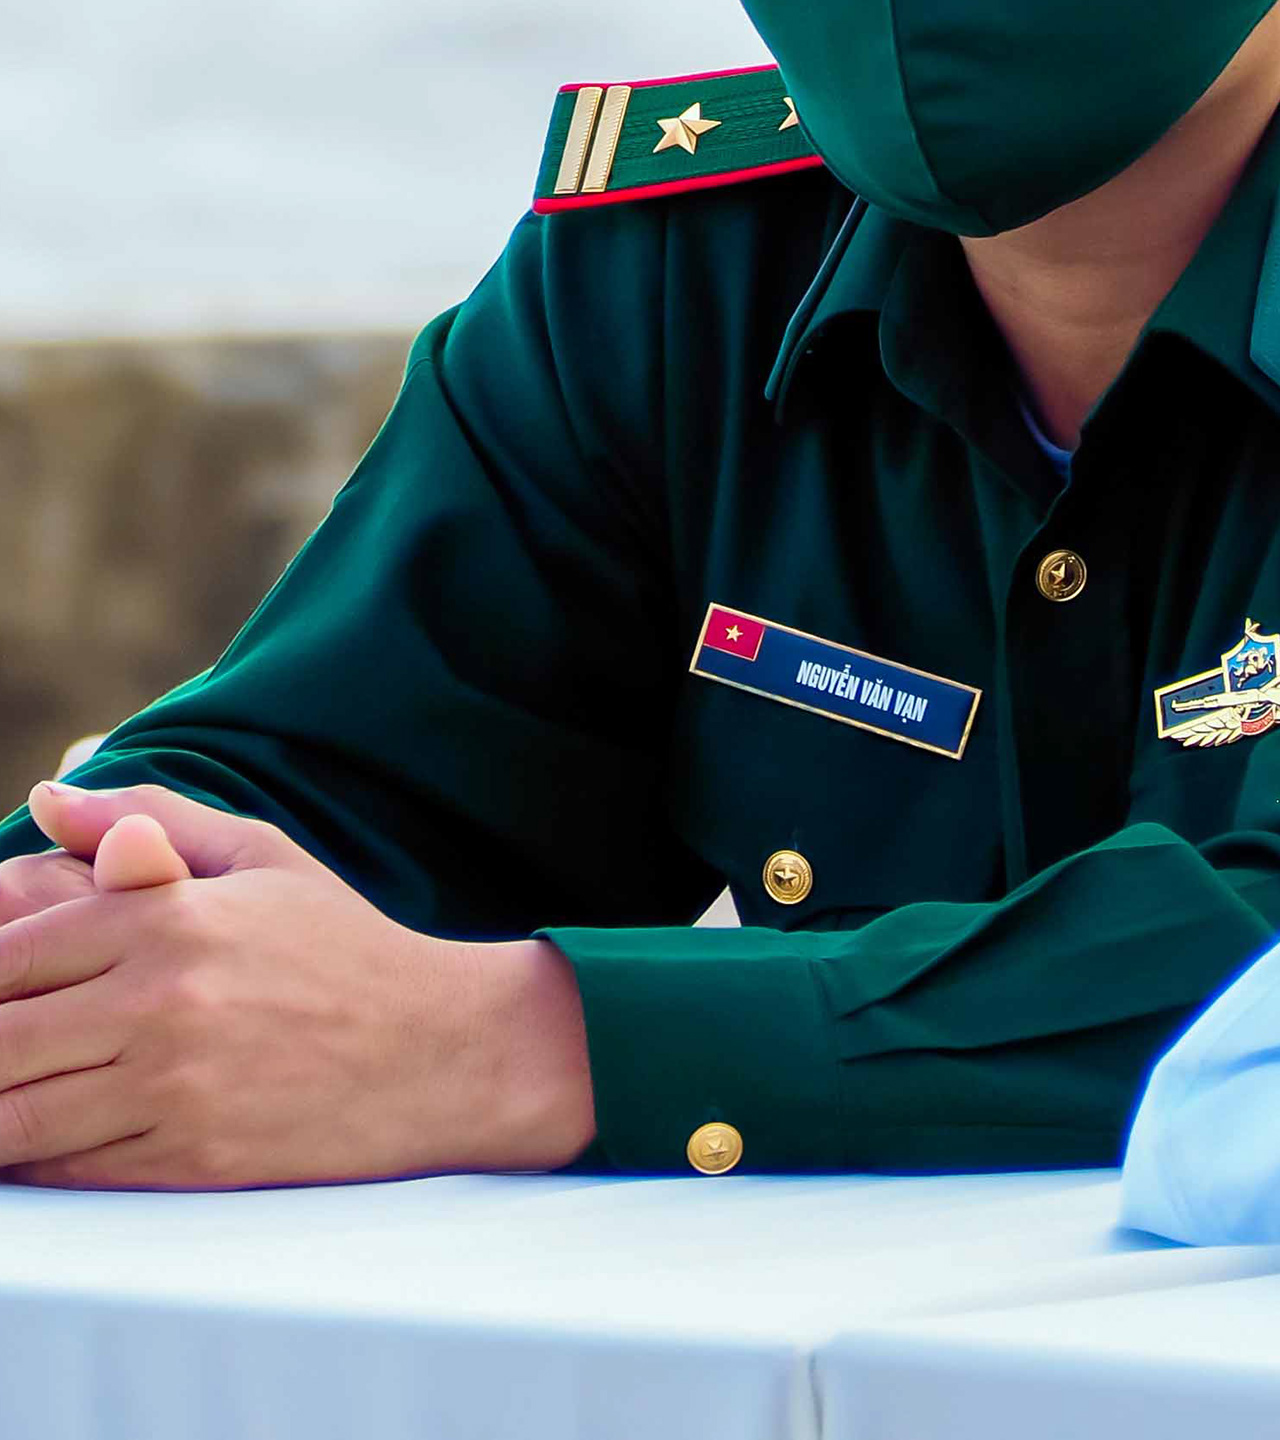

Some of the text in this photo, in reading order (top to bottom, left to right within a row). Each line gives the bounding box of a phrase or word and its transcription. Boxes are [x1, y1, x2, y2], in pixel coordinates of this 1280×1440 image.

[796, 659, 928, 723] NGUYỄN VĂN VẠN
